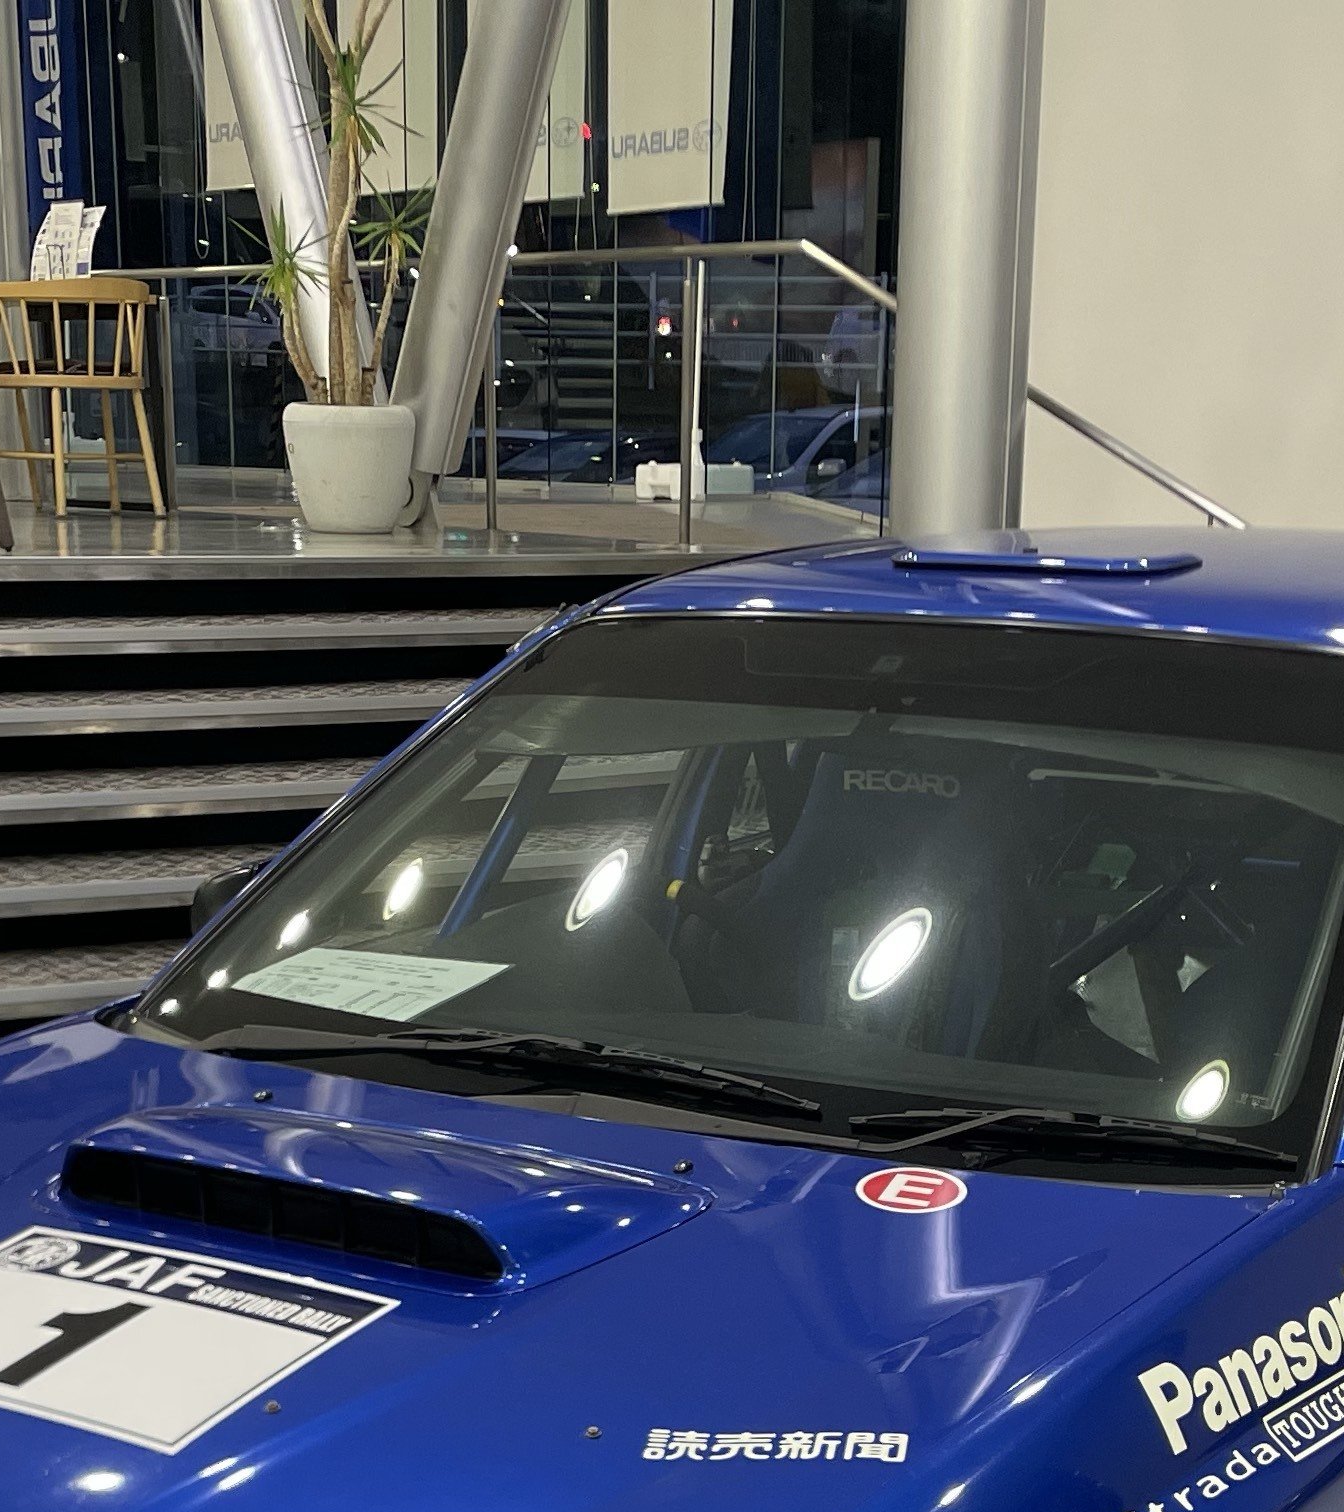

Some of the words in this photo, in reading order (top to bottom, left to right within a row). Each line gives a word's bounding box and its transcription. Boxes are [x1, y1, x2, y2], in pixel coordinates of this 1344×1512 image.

[843, 769, 961, 798] RECARO
[877, 1173, 945, 1208] E
[58, 1249, 227, 1295] JAF
[187, 1283, 301, 1323] SANCTIONED
[289, 1307, 353, 1333] RALLY
[642, 1428, 910, 1463] 読売新聞
